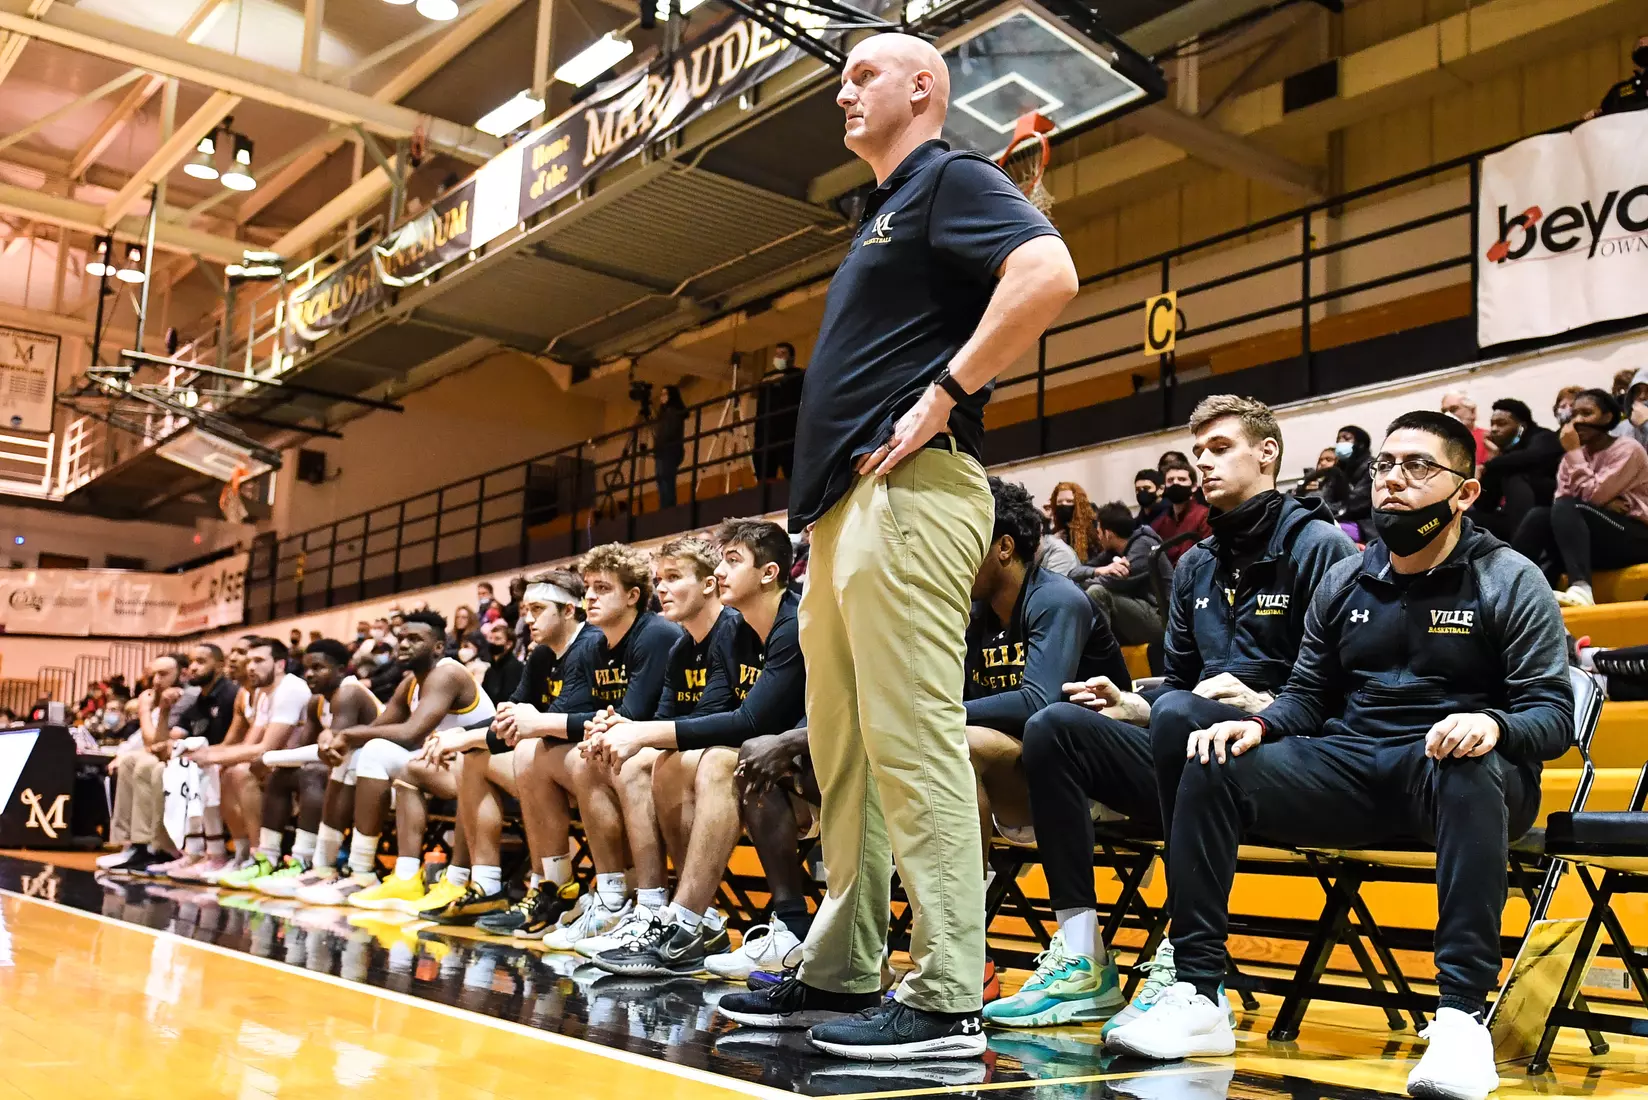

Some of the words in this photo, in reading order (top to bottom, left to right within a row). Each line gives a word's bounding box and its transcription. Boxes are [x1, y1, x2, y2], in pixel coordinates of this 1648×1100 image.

[1148, 297, 1173, 350] C
[1417, 517, 1440, 535] VILLE
[1256, 594, 1290, 609] VILLE
[1430, 609, 1475, 627] VILLE
[1427, 626, 1471, 635] BASKETBALL
